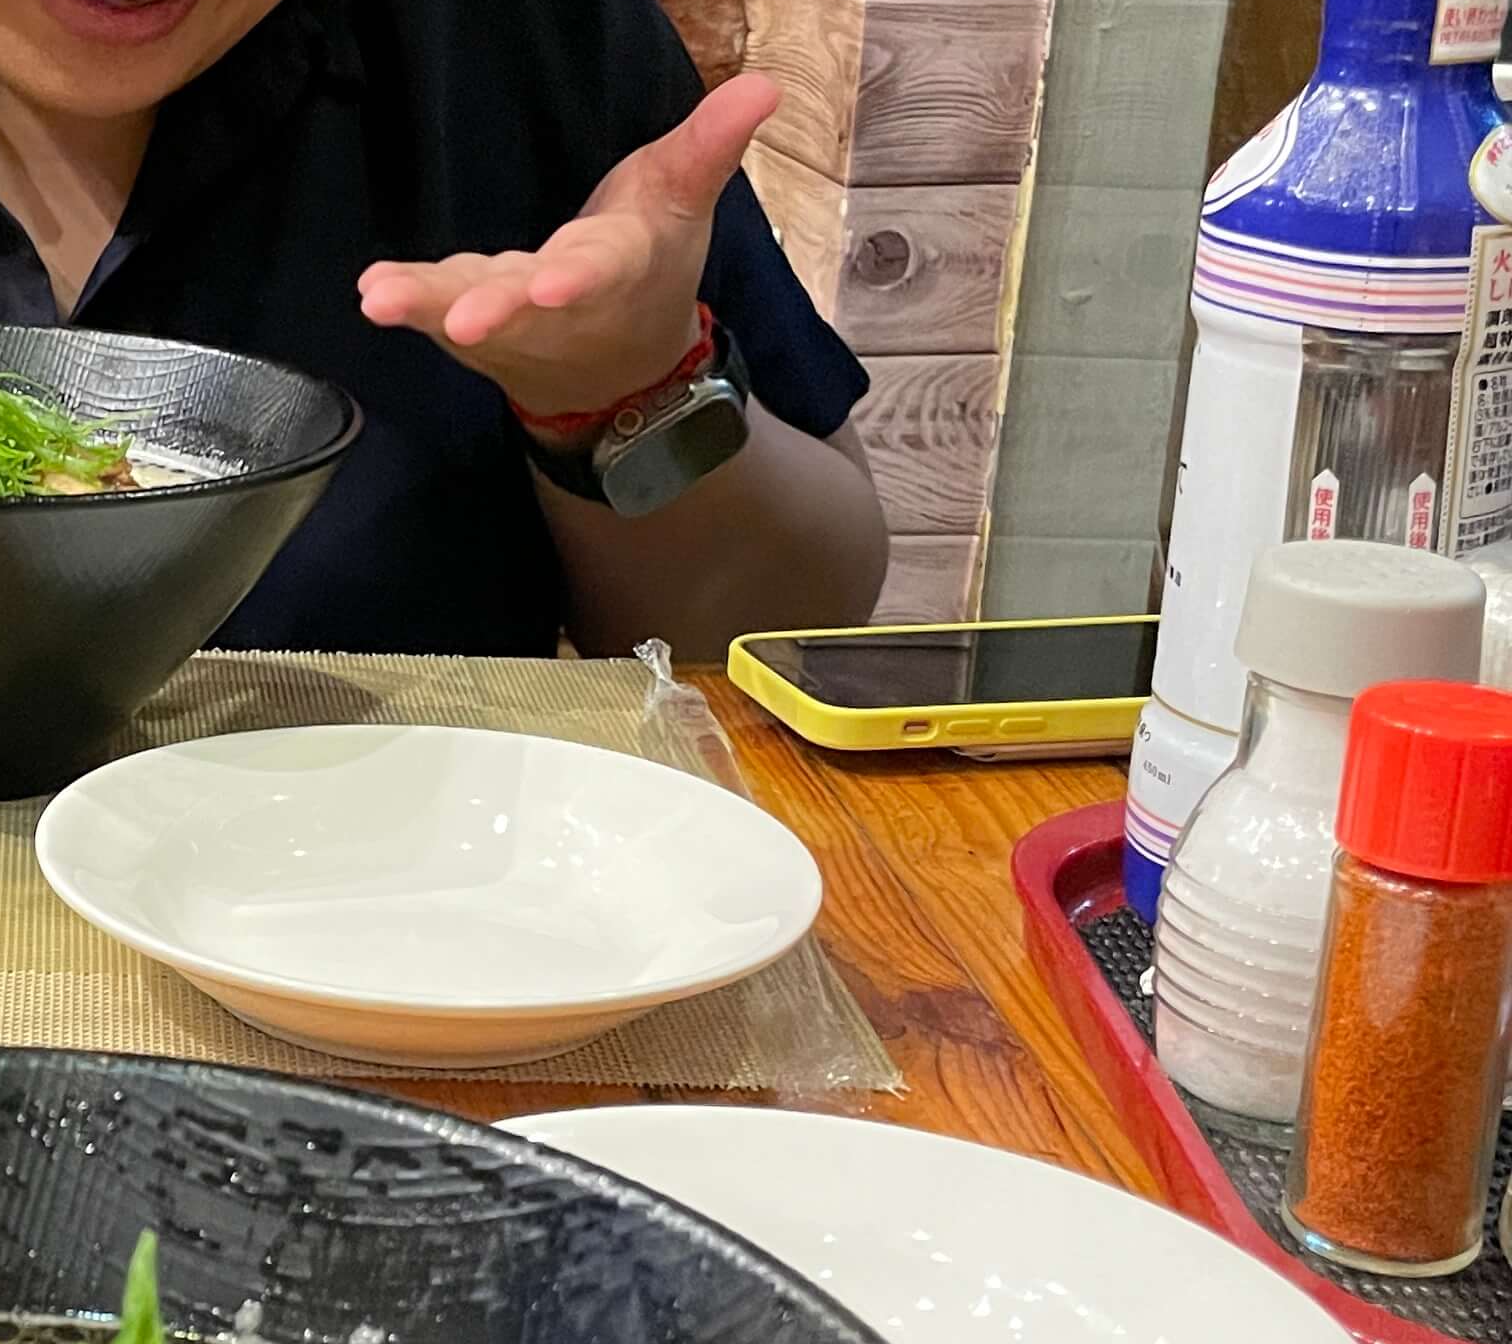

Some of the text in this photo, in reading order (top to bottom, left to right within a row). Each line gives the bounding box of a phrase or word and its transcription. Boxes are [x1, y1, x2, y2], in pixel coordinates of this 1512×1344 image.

[1488, 277, 1512, 303] し
[1408, 490, 1433, 550] 使用後
